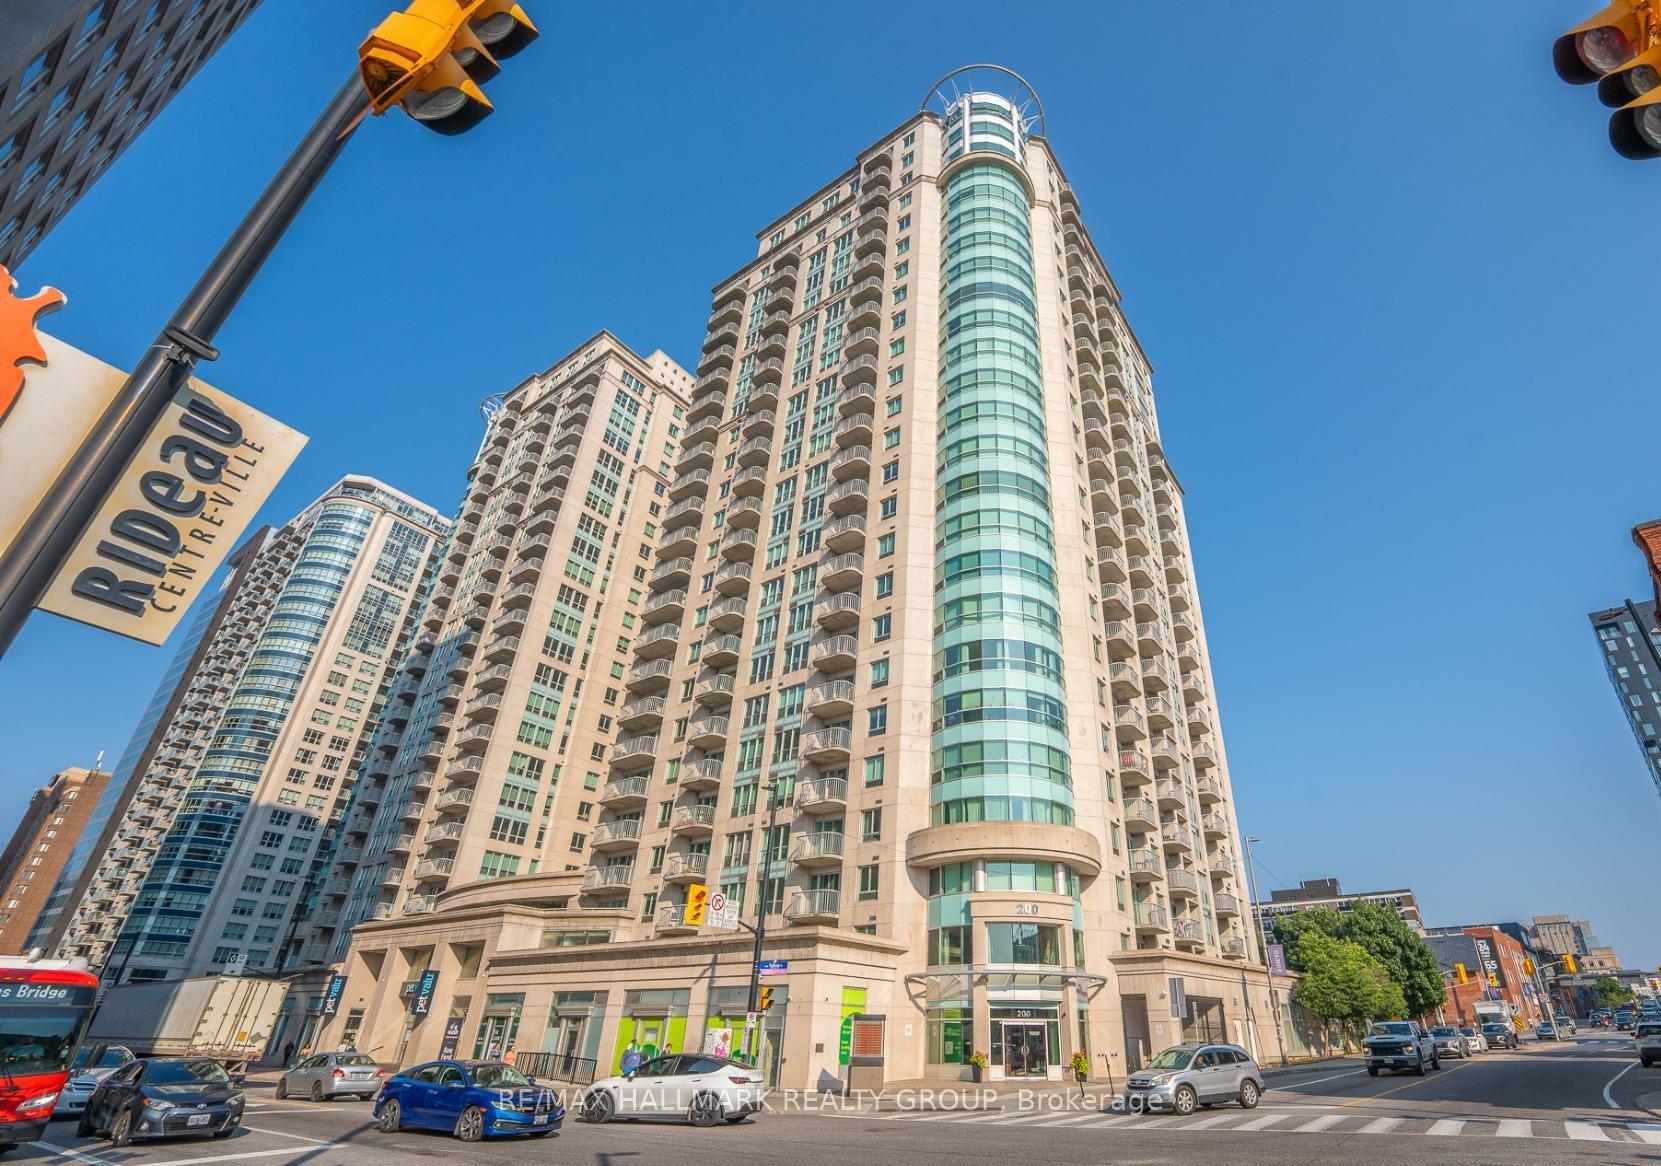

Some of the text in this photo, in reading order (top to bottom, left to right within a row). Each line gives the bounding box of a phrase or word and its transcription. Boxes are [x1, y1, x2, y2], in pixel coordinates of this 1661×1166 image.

[149, 437, 265, 613] CENTRE-VILLE
[1016, 903, 1038, 915] 200
[0, 984, 68, 999] s Bridge
[416, 995, 427, 1013] pet
[1017, 1010, 1031, 1018] 200
